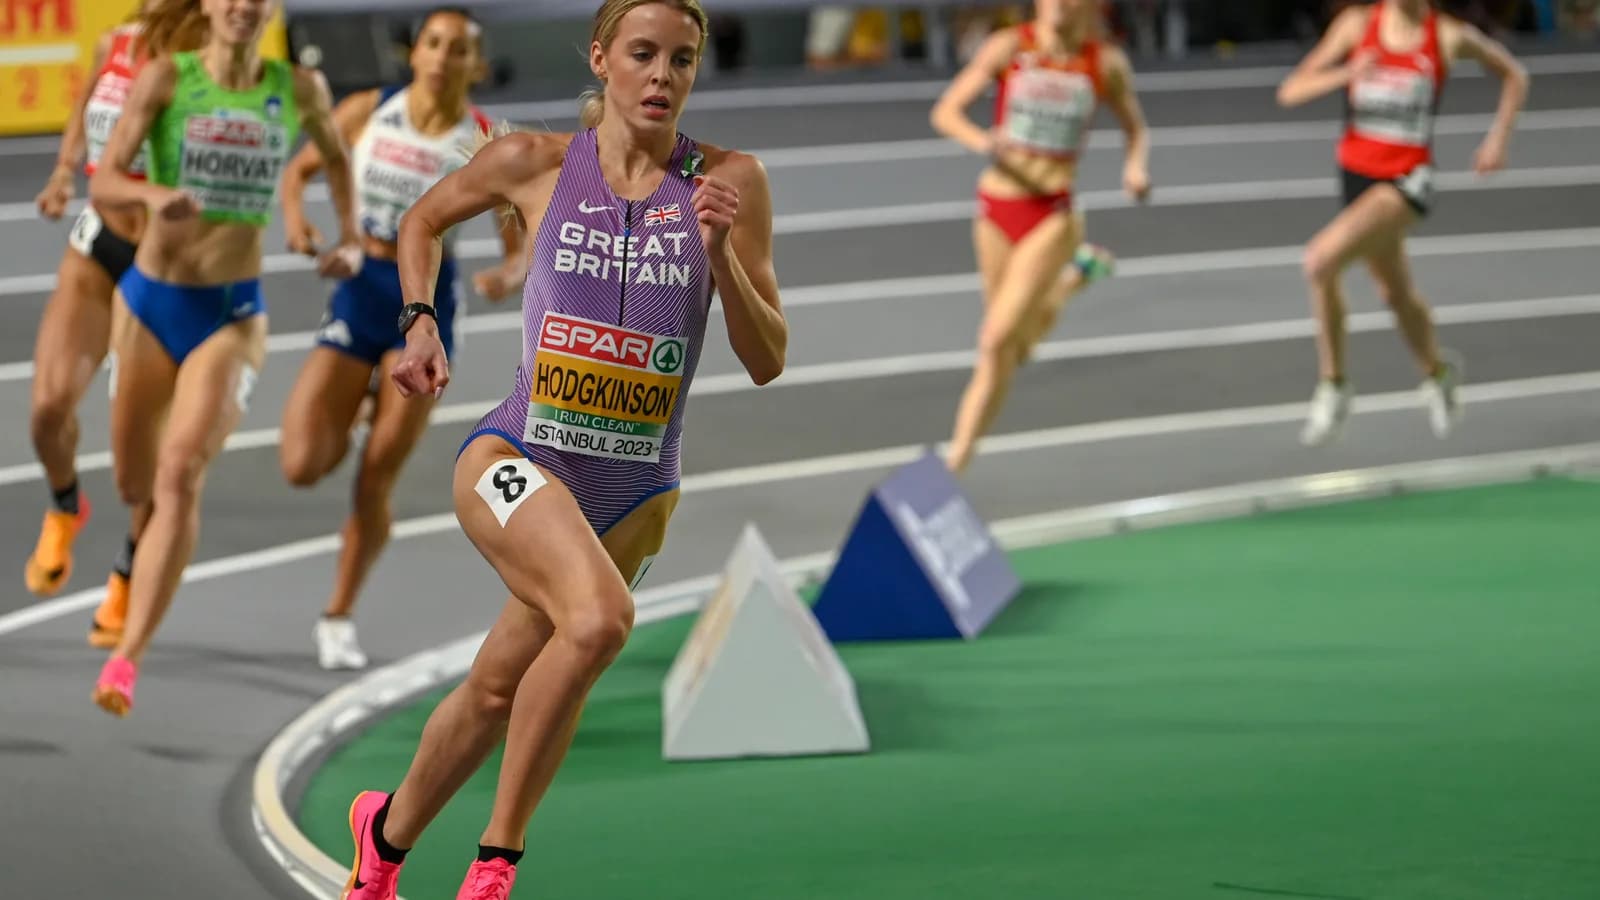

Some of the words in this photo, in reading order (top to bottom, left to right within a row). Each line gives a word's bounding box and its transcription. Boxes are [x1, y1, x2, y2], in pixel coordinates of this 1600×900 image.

[185, 148, 281, 179] HORVAT
[559, 221, 688, 258] GREAT
[554, 249, 690, 288] BRITAIN
[543, 321, 650, 363] SPAR
[536, 362, 674, 418] HODGKINSON
[554, 408, 558, 420] I
[560, 410, 589, 425] RUN
[534, 423, 610, 453] ISTANBUL
[612, 439, 653, 456] 2023
[493, 464, 528, 504] 8
